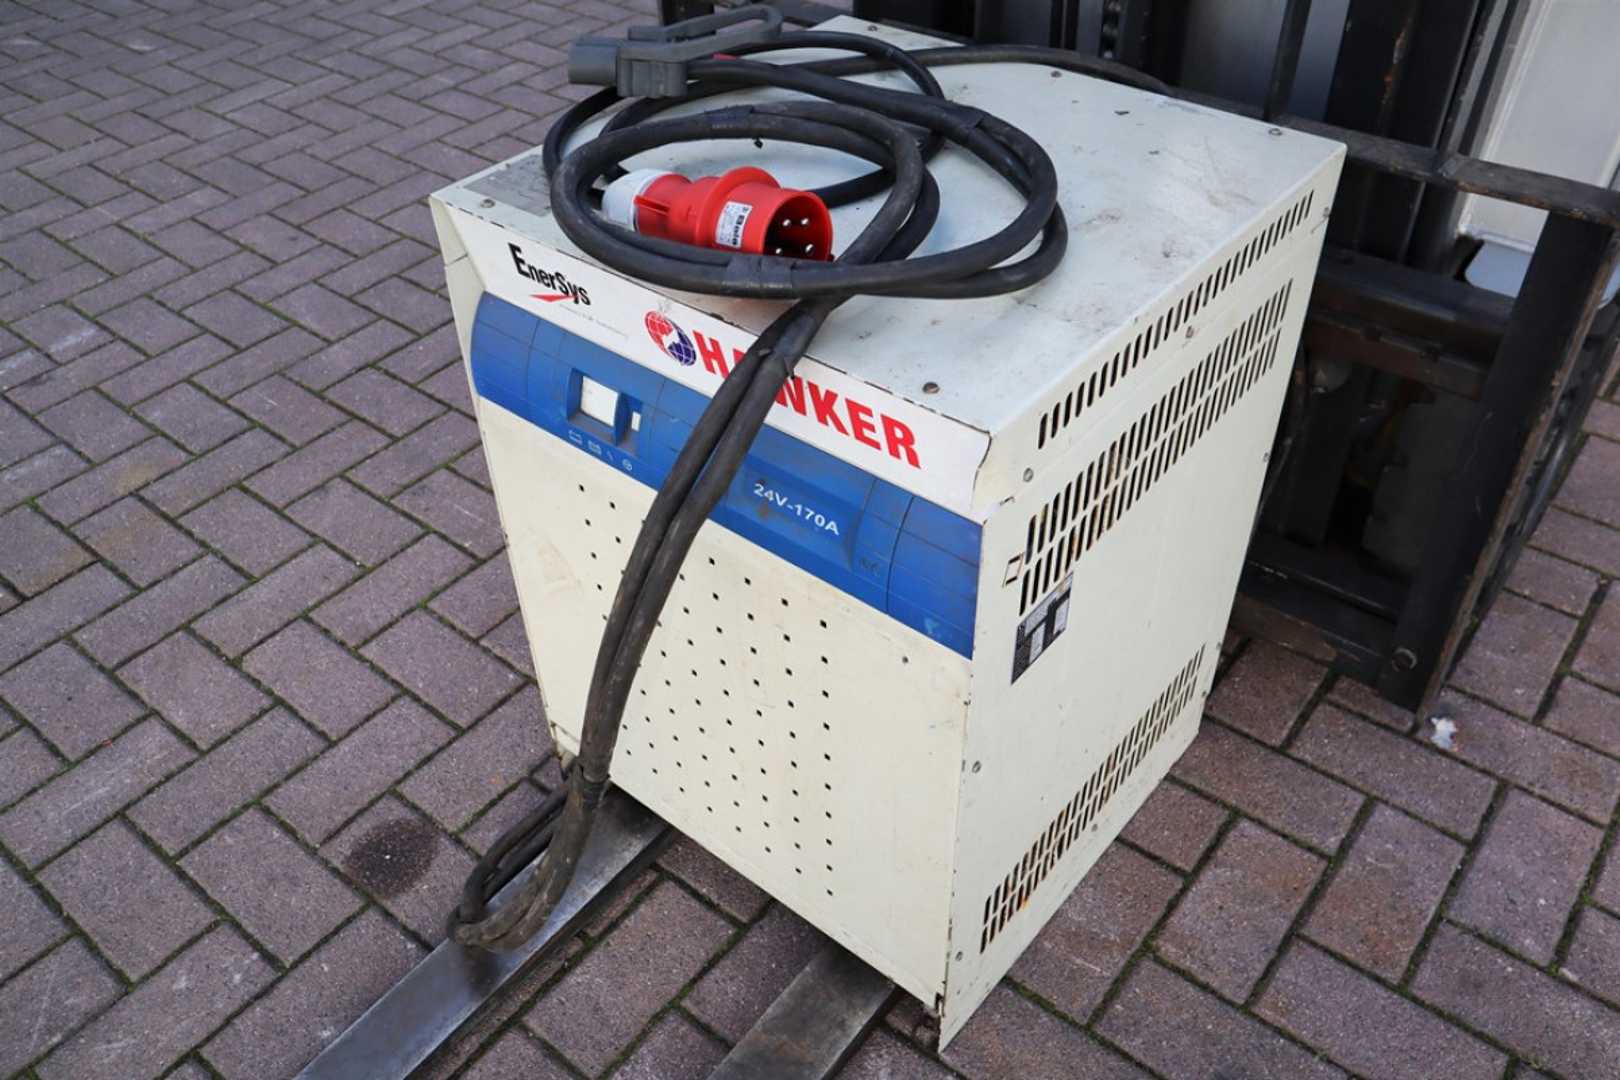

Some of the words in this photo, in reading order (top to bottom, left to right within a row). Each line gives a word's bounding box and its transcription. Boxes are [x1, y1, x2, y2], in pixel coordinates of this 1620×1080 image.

[507, 241, 592, 306] EnerSys
[693, 330, 921, 469] HWKER
[754, 483, 840, 536] 24V-170A
